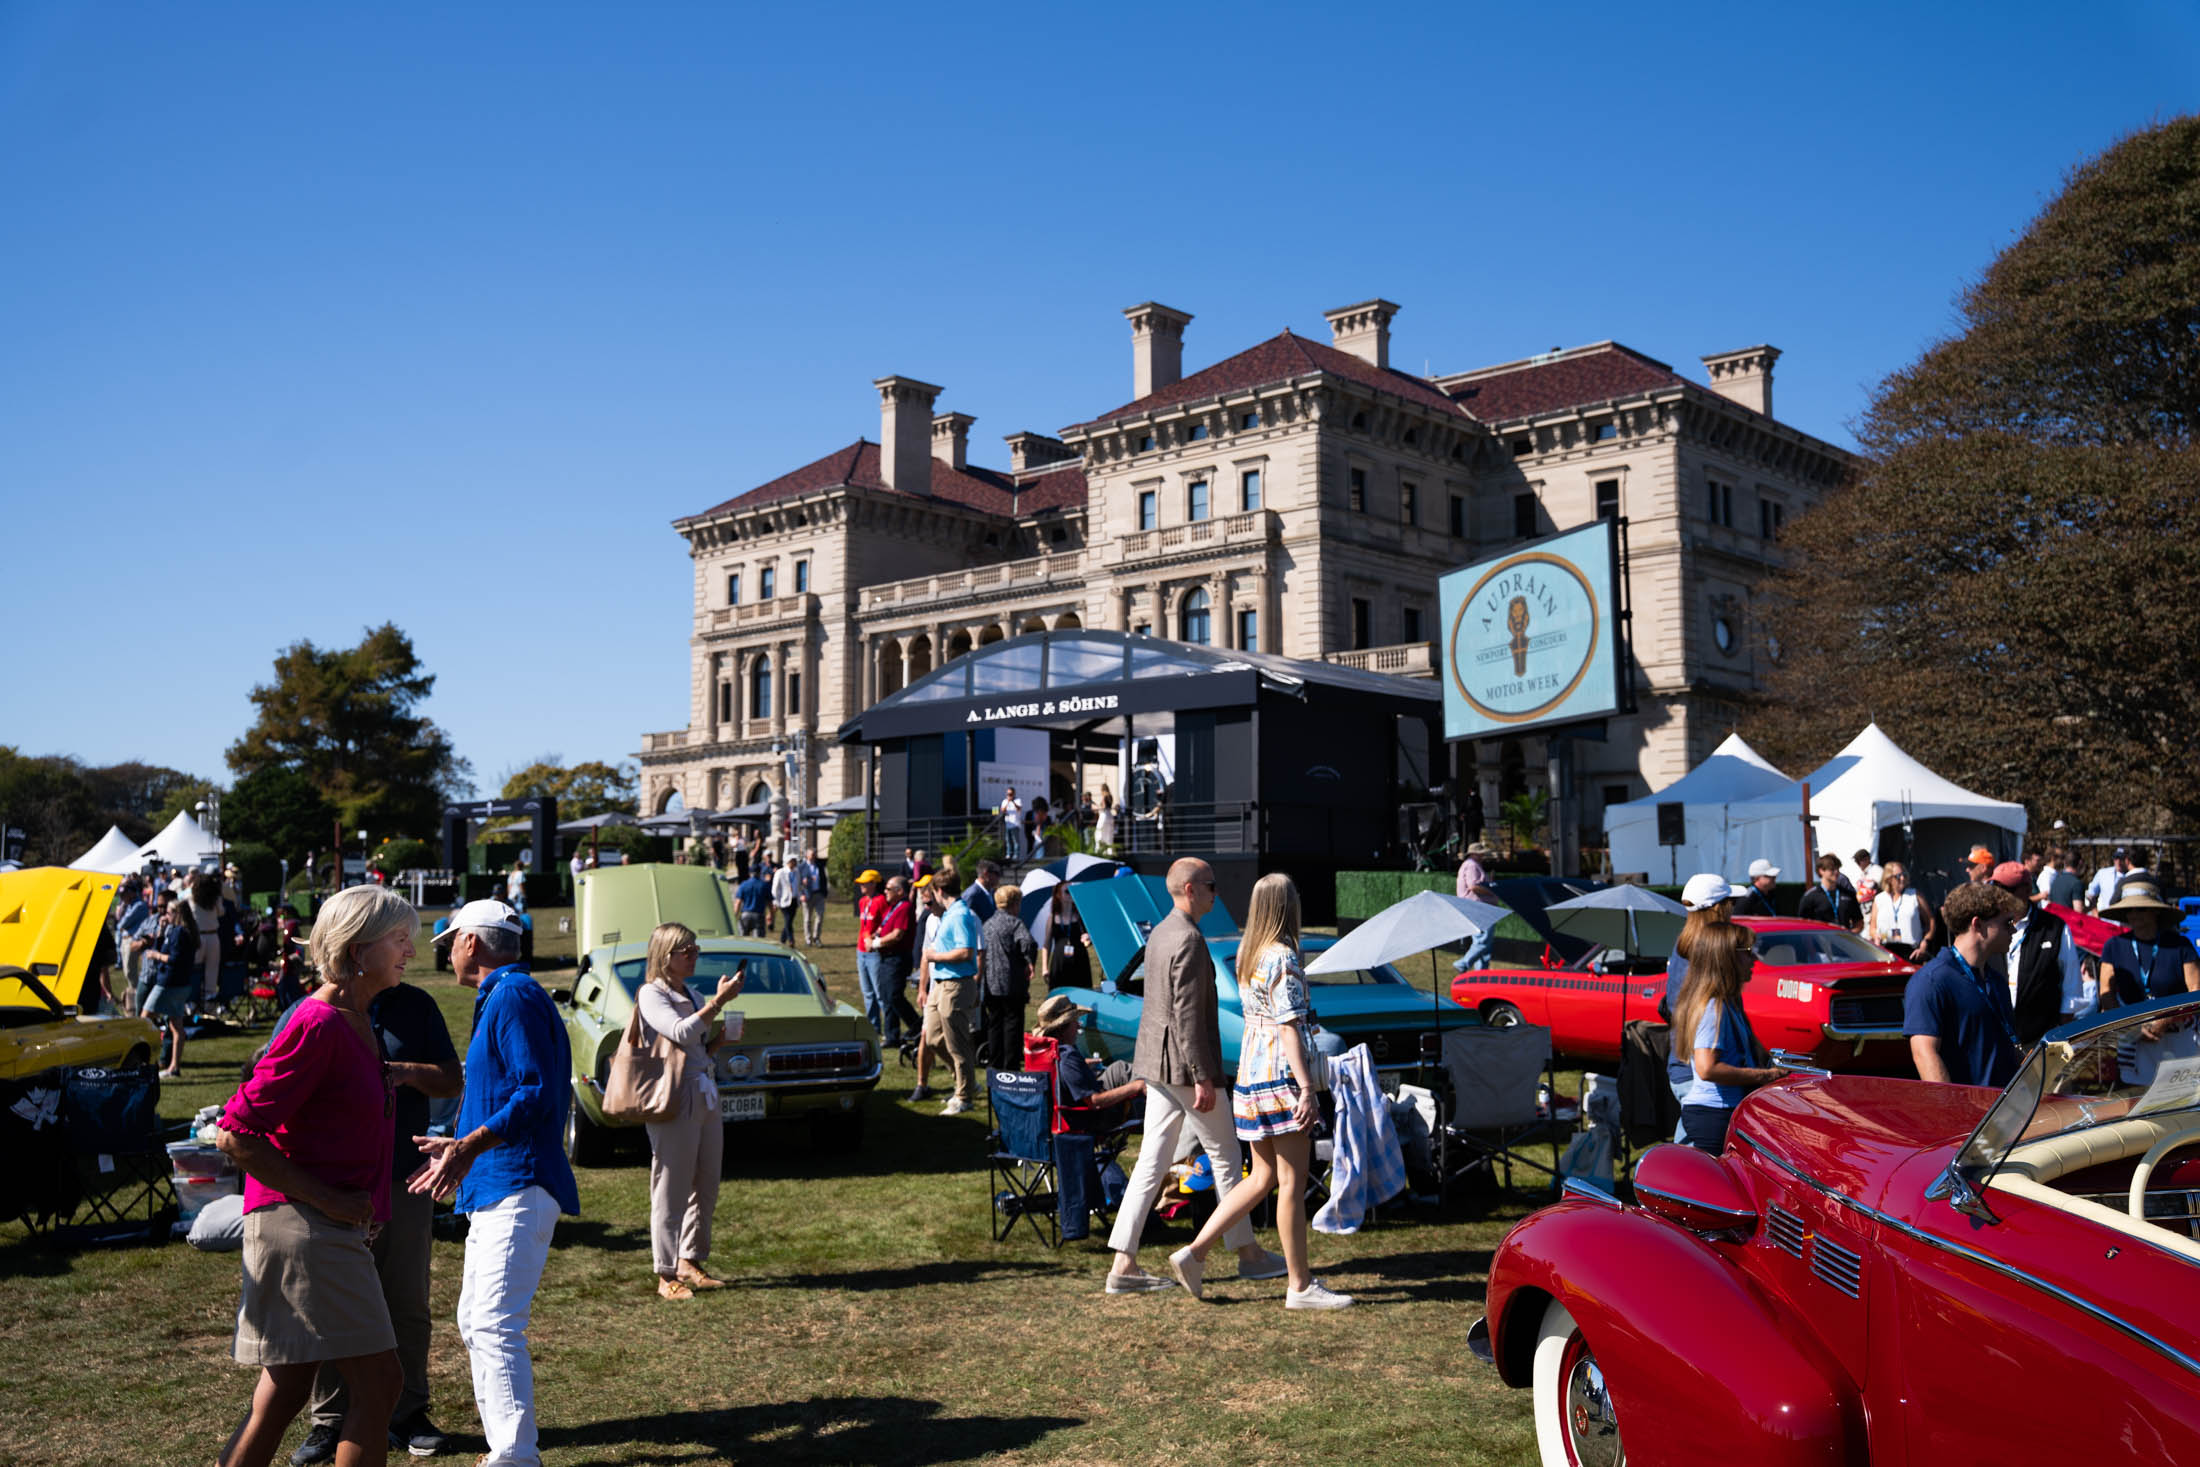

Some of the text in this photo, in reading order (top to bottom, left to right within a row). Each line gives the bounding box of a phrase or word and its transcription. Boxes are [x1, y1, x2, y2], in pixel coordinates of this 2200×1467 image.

[1482, 573, 1557, 632] AUDRAIN
[1476, 647, 1508, 662] NEWPORT
[1486, 673, 1559, 700] MOTOR WEEK
[966, 695, 1118, 722] A. LANGE & SÖHNE
